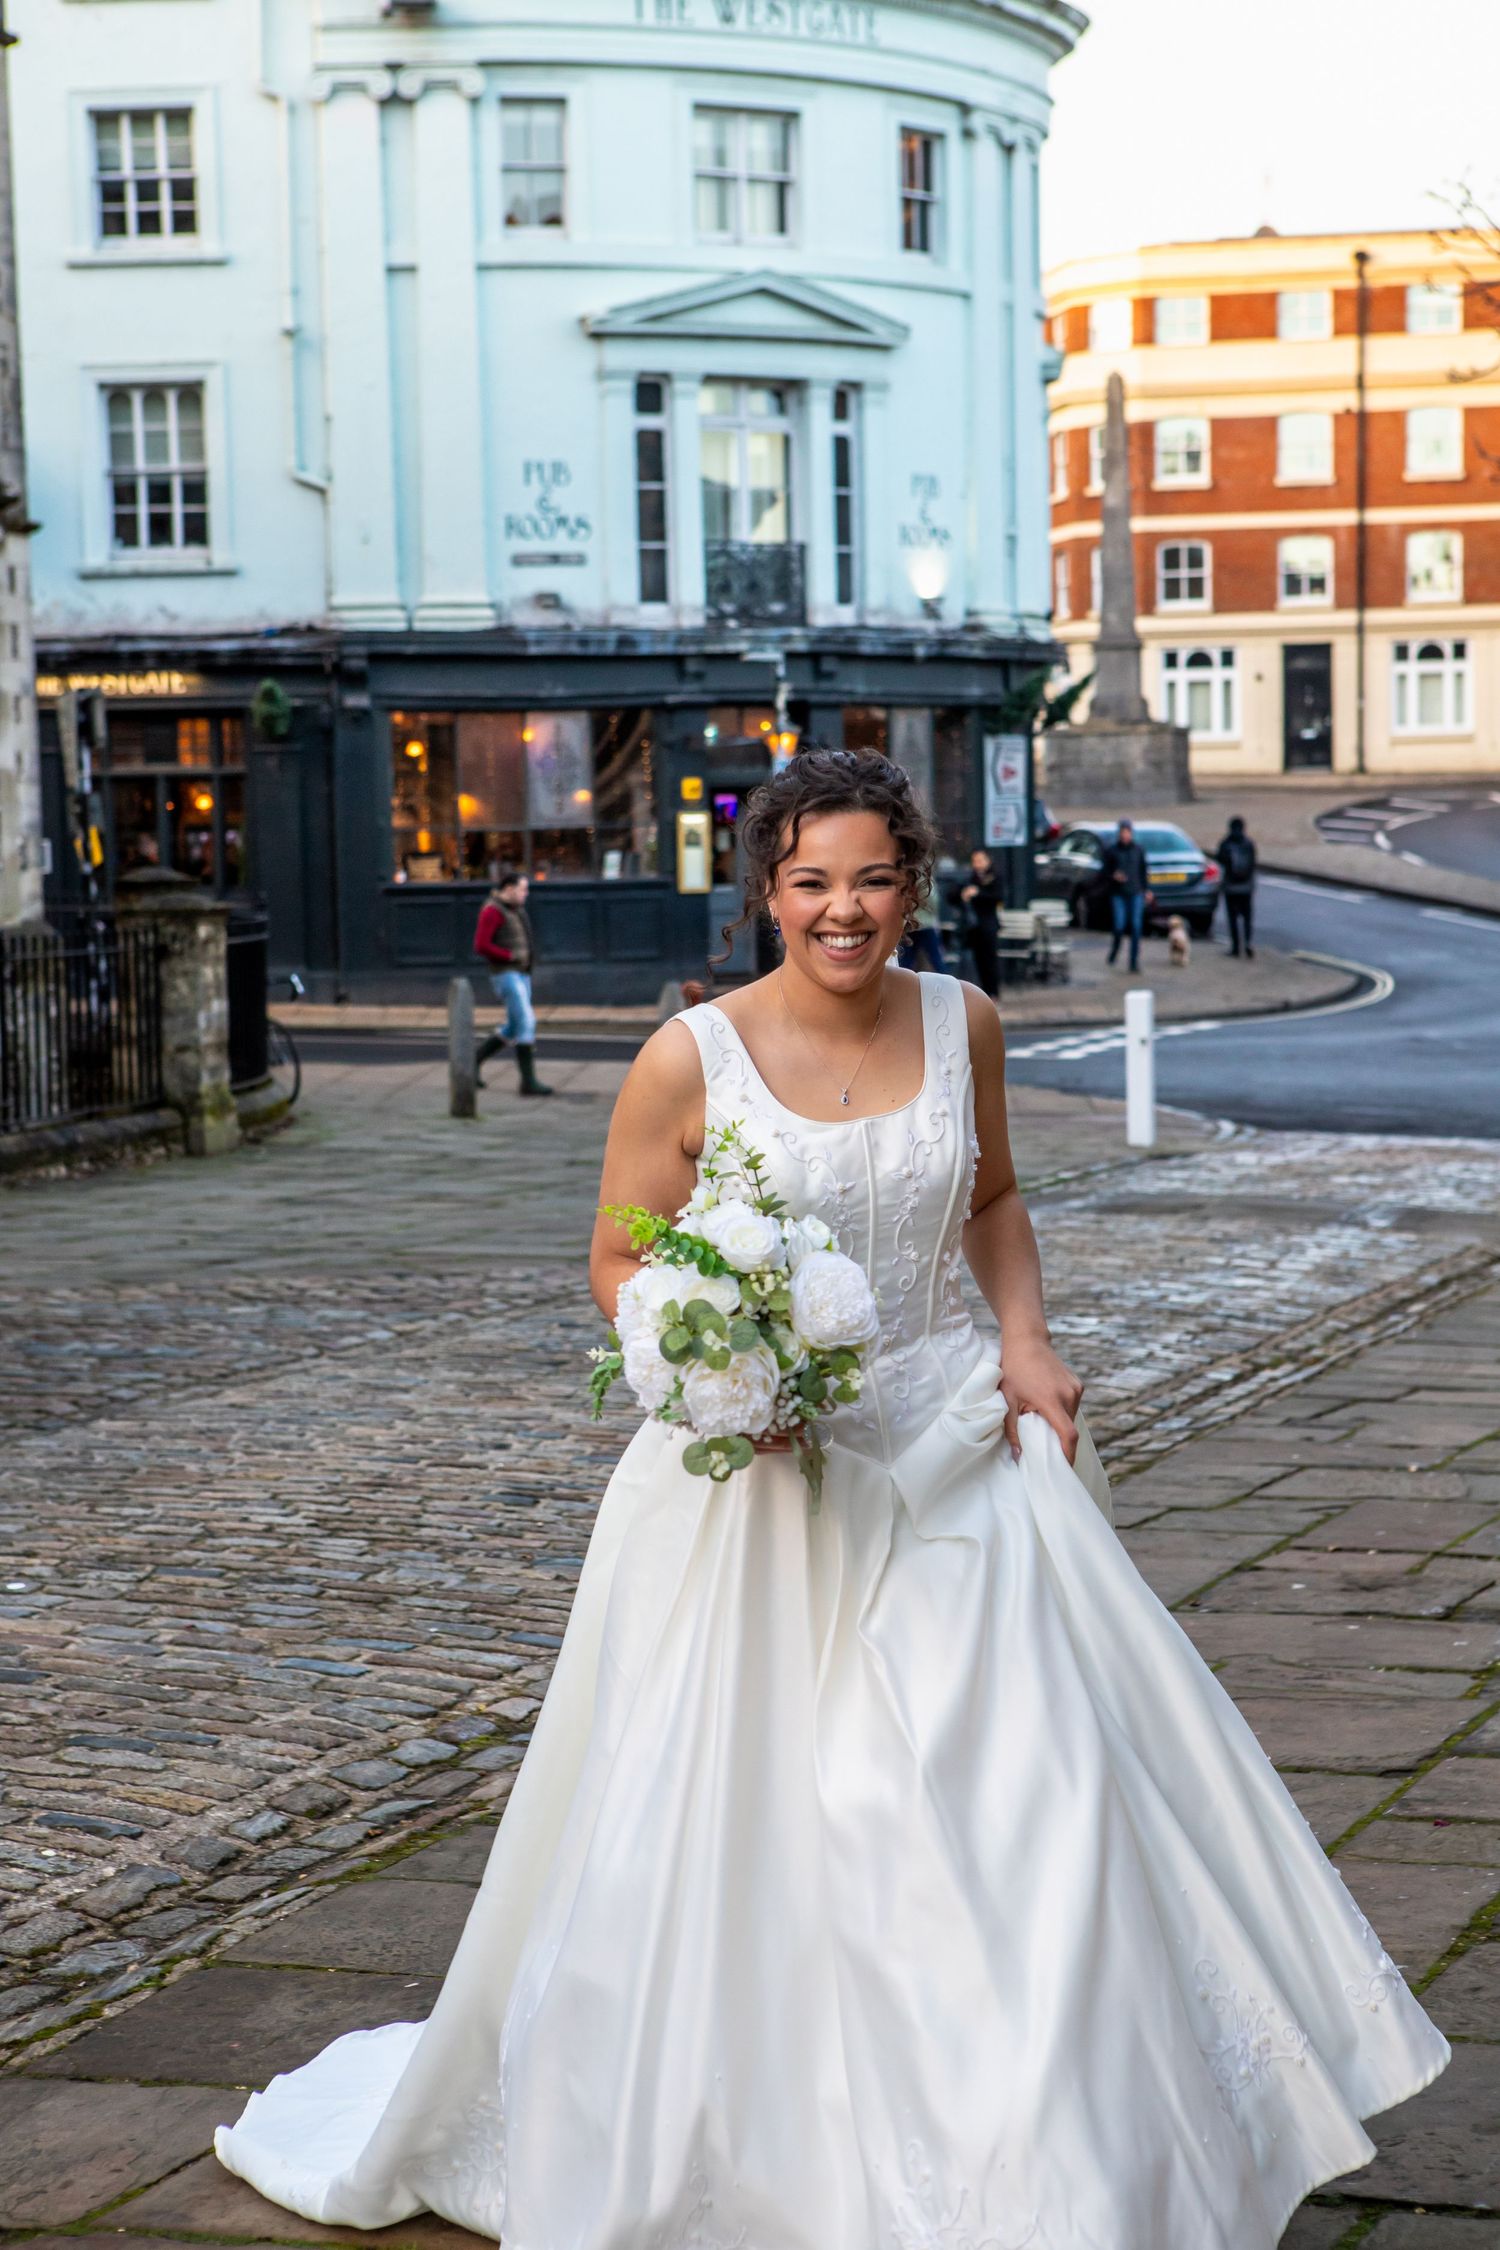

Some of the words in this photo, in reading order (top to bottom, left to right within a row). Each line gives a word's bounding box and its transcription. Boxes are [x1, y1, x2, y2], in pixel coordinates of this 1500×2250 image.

[711, 0, 878, 46] WESTGATE
[522, 460, 571, 487] PUB
[503, 514, 592, 541] ROOMS
